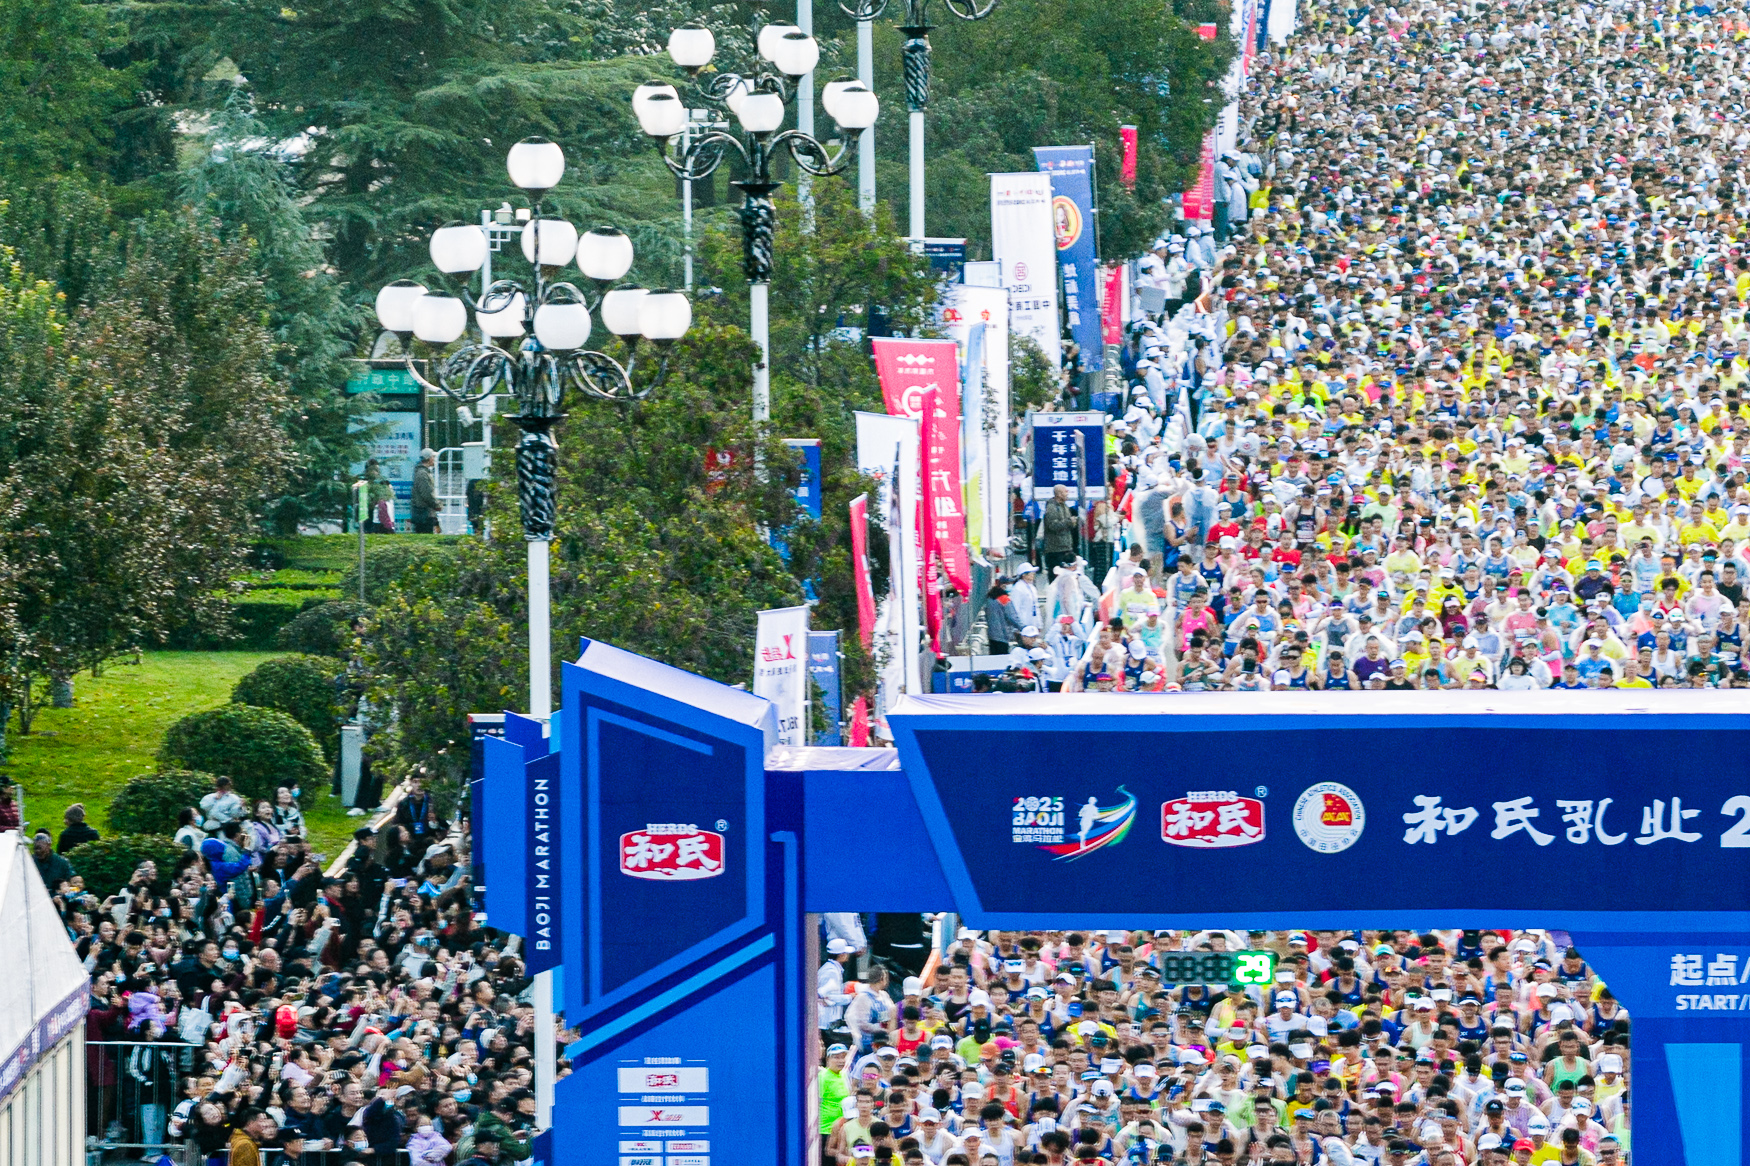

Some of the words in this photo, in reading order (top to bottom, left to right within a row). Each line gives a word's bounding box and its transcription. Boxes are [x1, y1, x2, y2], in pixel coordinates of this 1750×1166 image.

[1012, 797, 1064, 811] 2025
[1012, 812, 1064, 826] BAOJI
[535, 779, 550, 888] MARATHON
[646, 824, 698, 835] HERDS
[1012, 827, 1063, 835] MARATHON
[1166, 803, 1262, 837] 和氏
[1403, 796, 1703, 846] 和氏乳业
[624, 835, 720, 870] 和氏
[535, 896, 550, 950] BAOJI
[1236, 955, 1271, 982] 29
